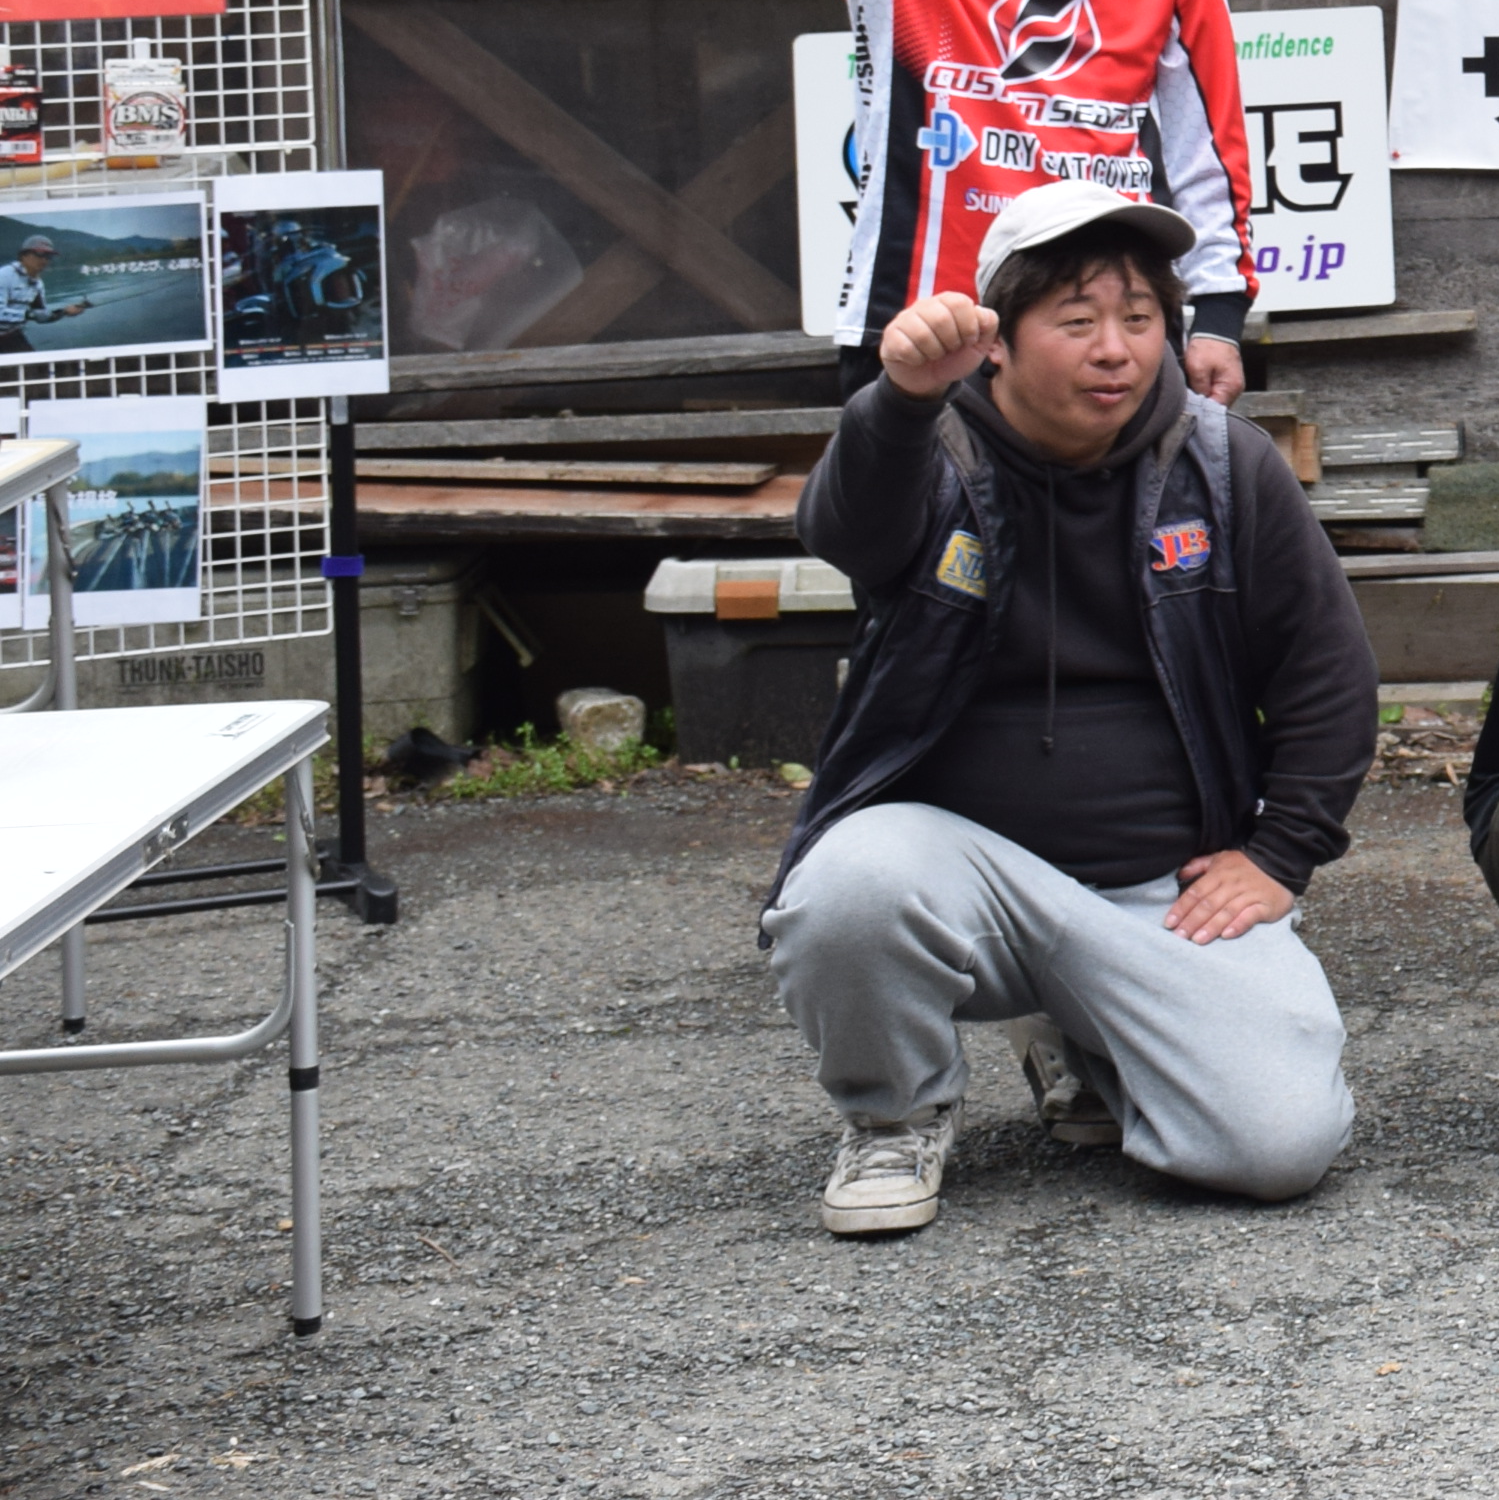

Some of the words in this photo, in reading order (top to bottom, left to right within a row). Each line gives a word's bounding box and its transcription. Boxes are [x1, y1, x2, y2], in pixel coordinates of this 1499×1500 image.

[115, 104, 180, 125] BMS
[985, 130, 1037, 168] DRY
[1093, 158, 1150, 188] COVER
[950, 545, 985, 580] NB
[1151, 528, 1210, 572] JB
